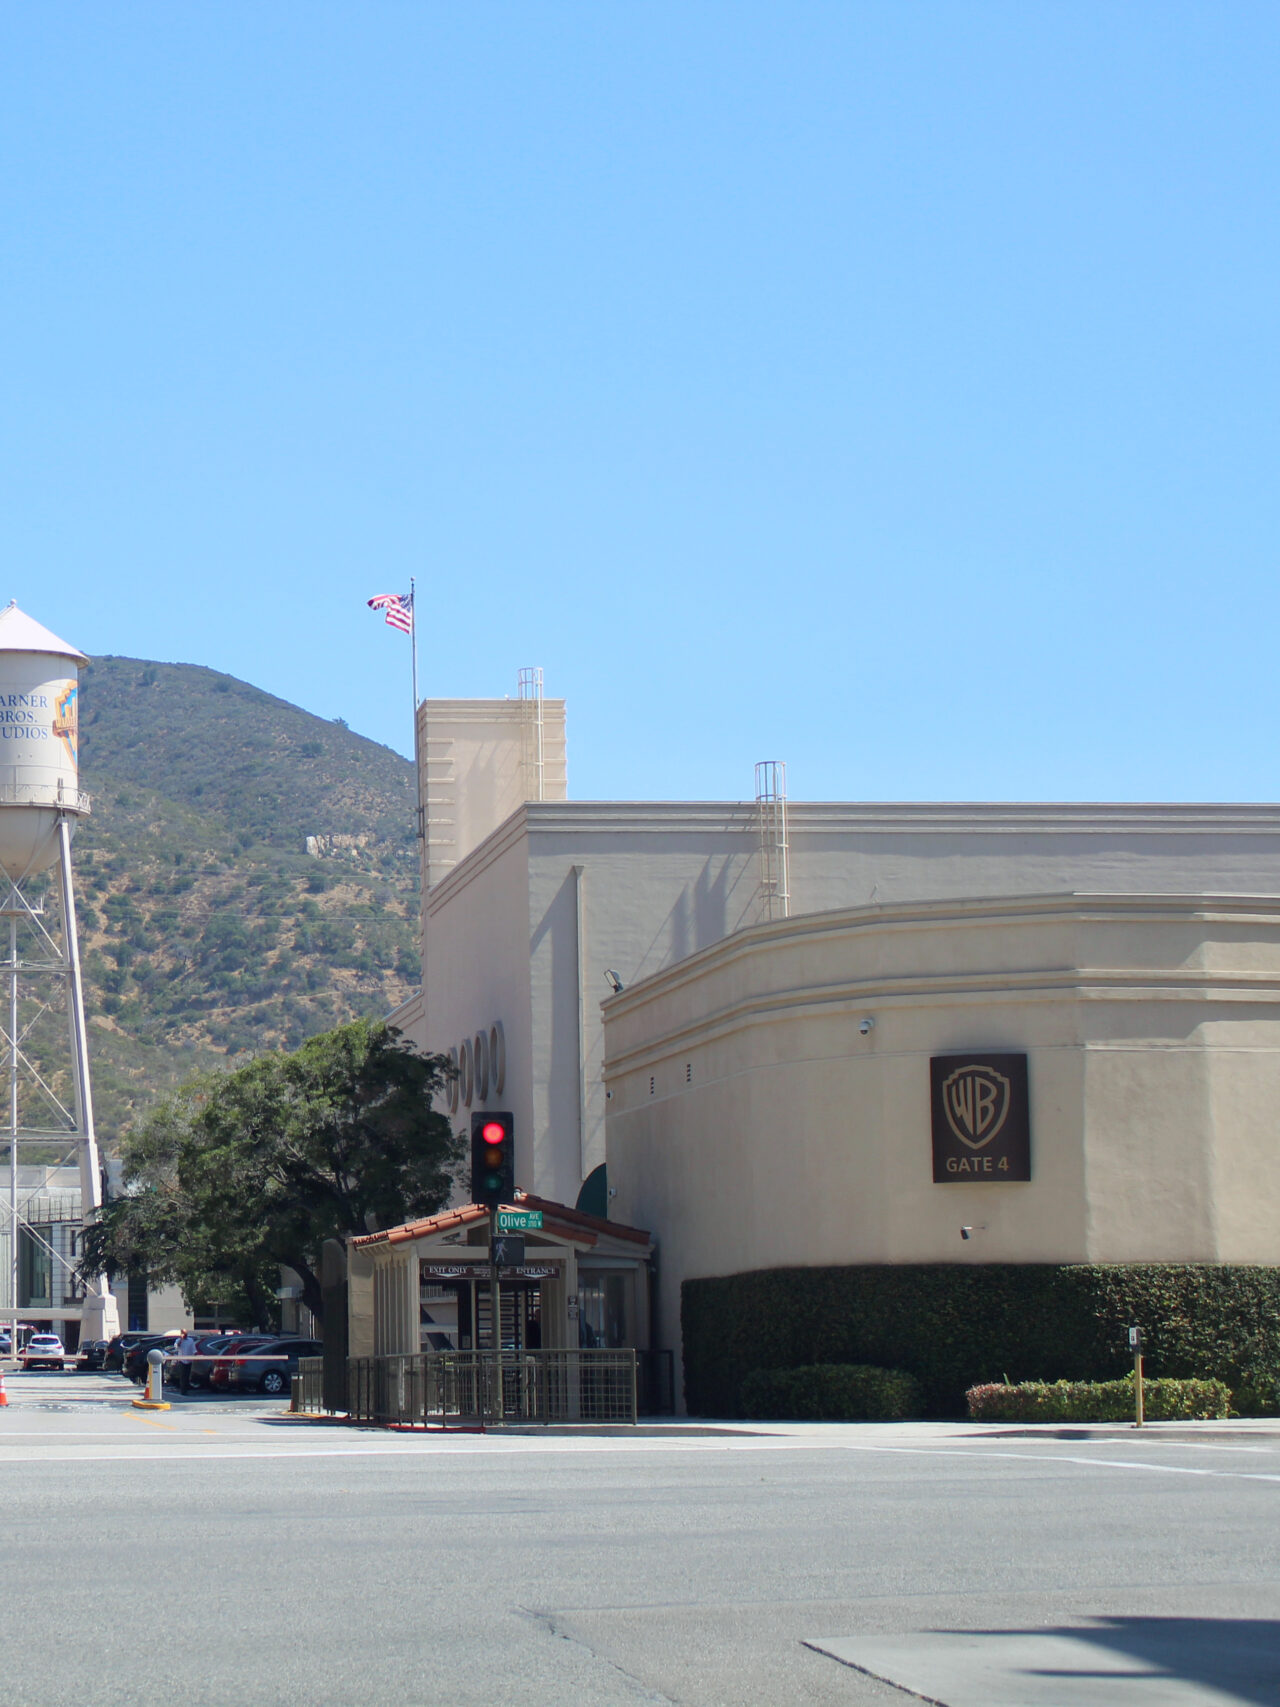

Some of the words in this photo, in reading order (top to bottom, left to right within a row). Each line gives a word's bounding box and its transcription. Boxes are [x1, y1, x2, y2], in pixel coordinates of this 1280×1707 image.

[951, 1075, 998, 1137] WB
[946, 1157, 992, 1172] GATE
[998, 1157, 1009, 1171] 4
[500, 1214, 527, 1227] Olive
[429, 1266, 447, 1274] EXIT
[448, 1266, 468, 1274] ONLY
[516, 1267, 556, 1275] ENTRANCE
